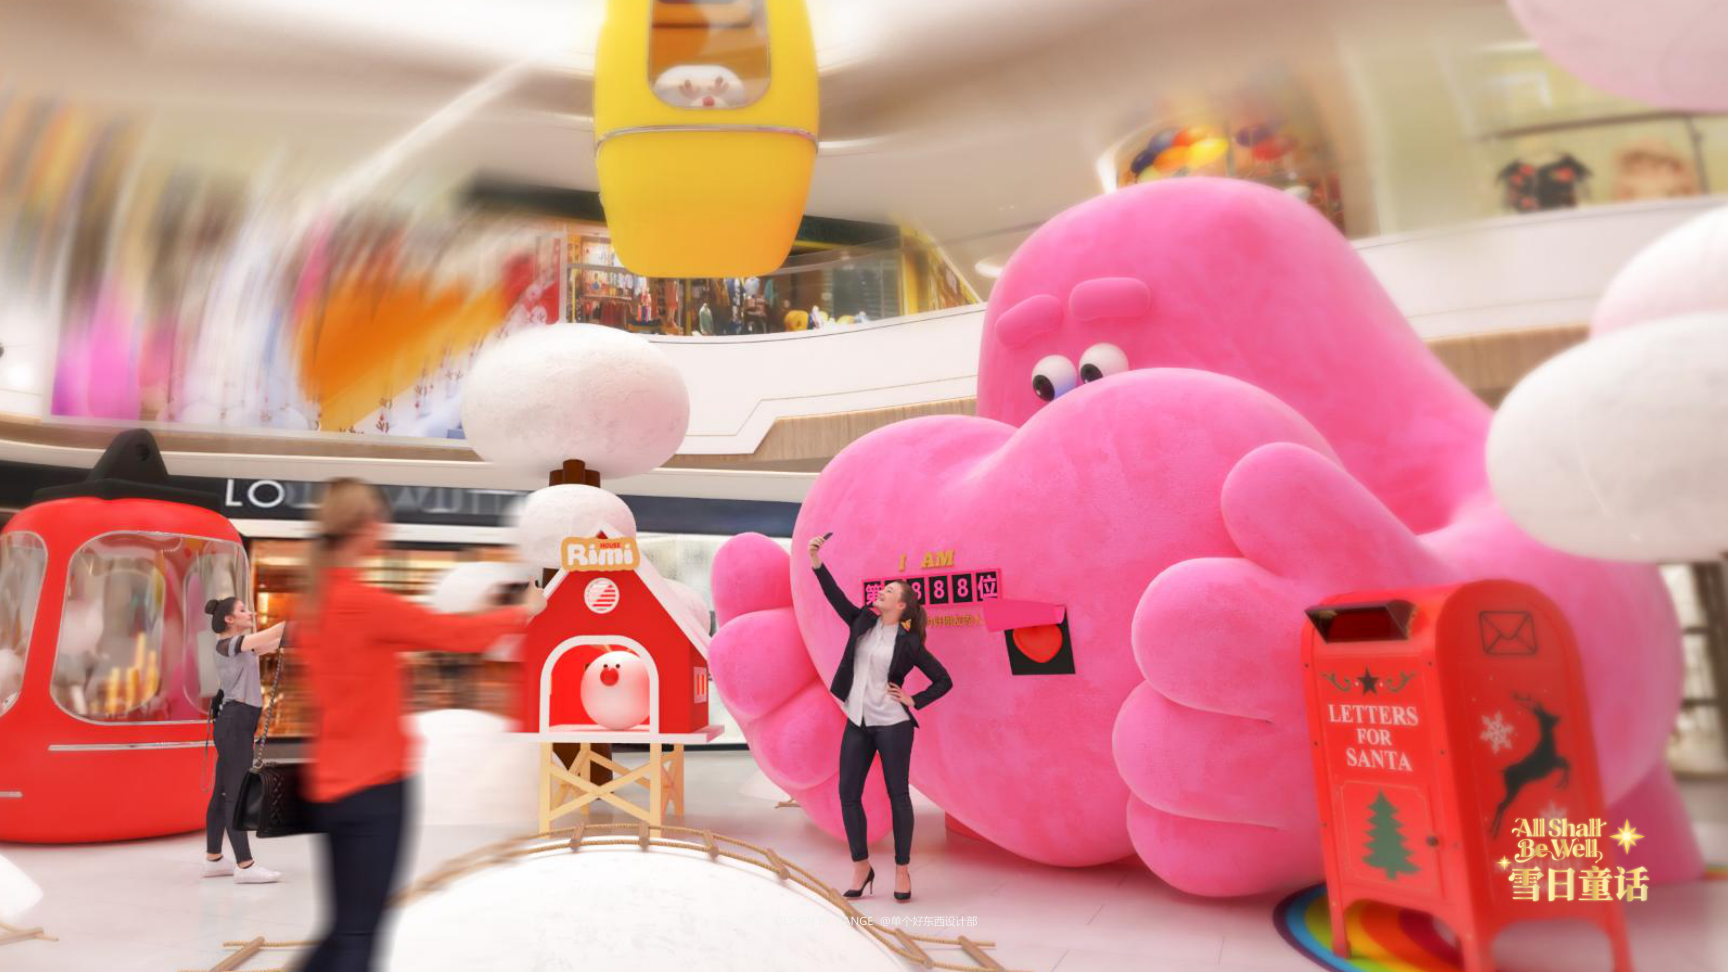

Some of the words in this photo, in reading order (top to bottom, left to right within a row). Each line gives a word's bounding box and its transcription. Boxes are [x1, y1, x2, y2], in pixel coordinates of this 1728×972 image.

[567, 543, 634, 566] Rimi
[898, 554, 907, 572] I
[921, 550, 955, 569] AM
[1327, 703, 1419, 726] LETTERS
[1356, 728, 1392, 746] FOR
[1345, 747, 1414, 772] SANTA
